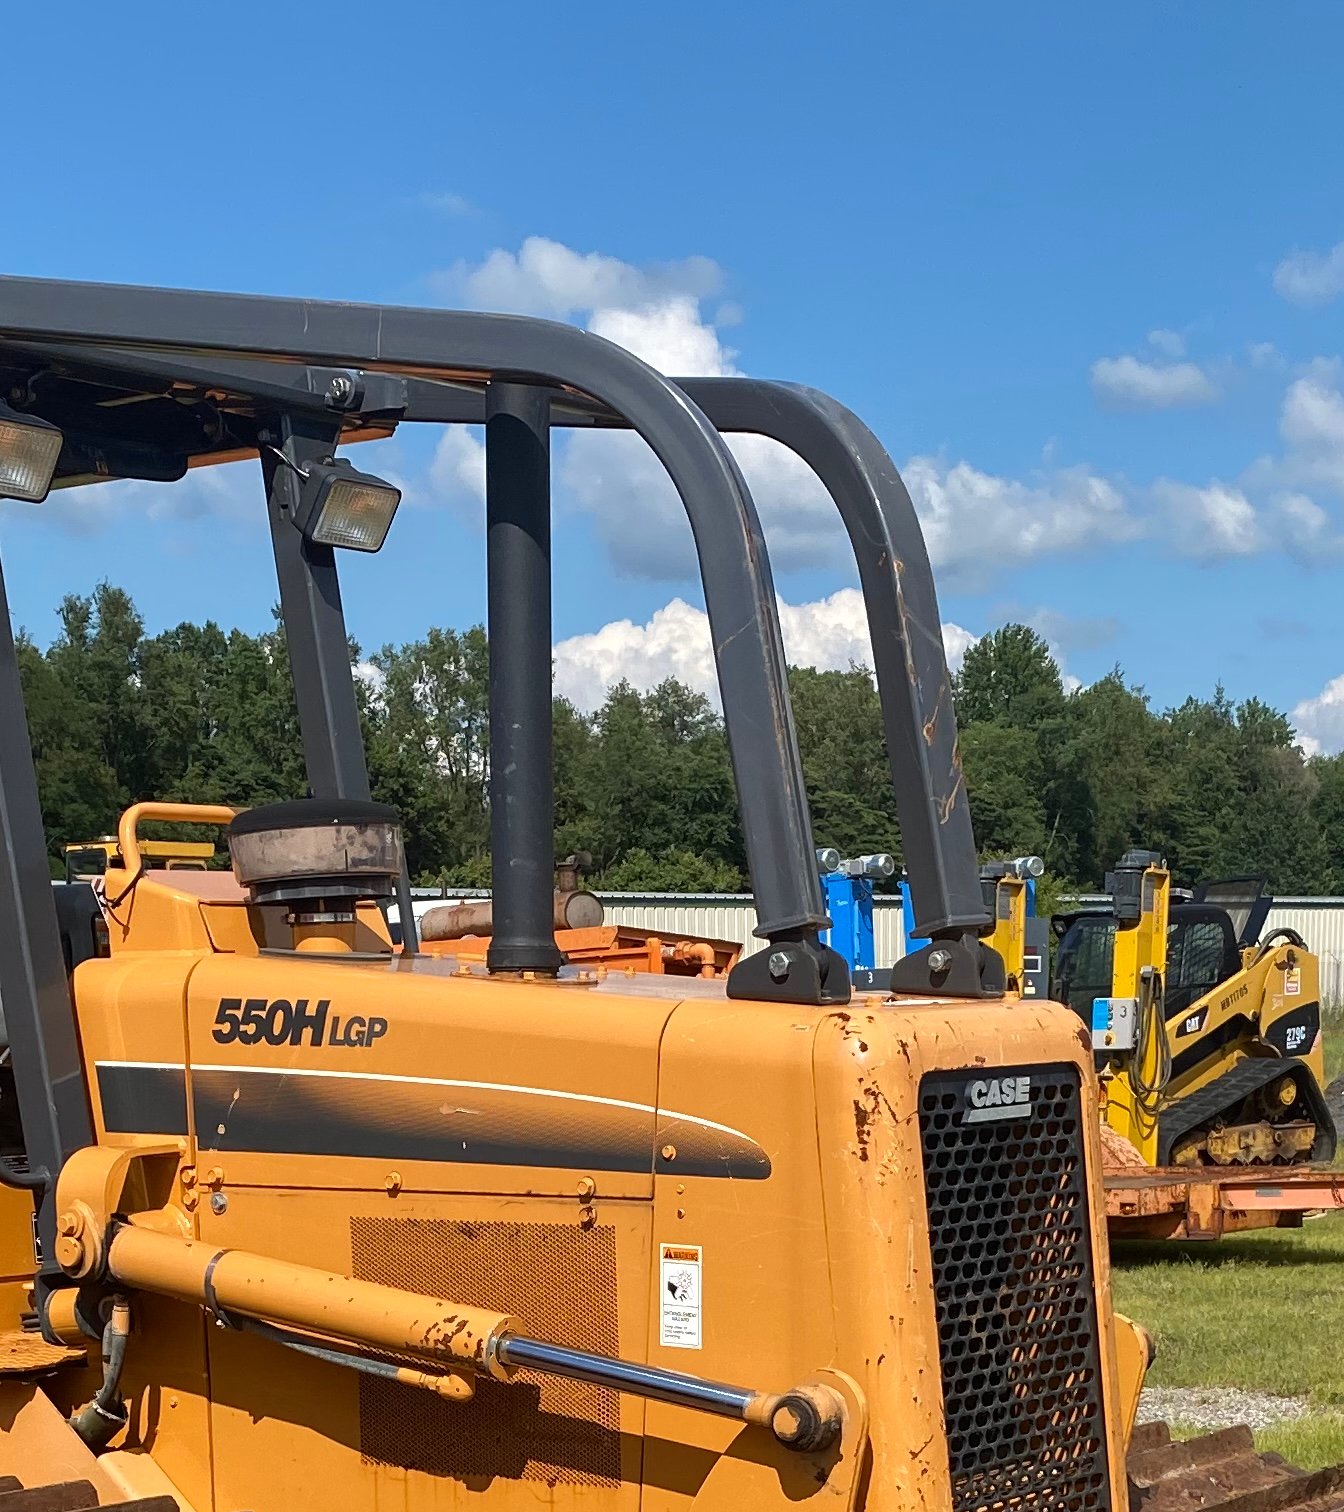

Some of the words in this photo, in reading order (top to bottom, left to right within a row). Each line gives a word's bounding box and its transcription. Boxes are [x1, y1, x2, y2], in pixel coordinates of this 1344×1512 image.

[1120, 1005, 1127, 1018] 3
[211, 997, 331, 1047] 550H
[328, 1016, 388, 1047] LGP
[1186, 1016, 1200, 1032] CAT
[1286, 1026, 1306, 1042] 279C
[971, 1076, 1031, 1108] CASE
